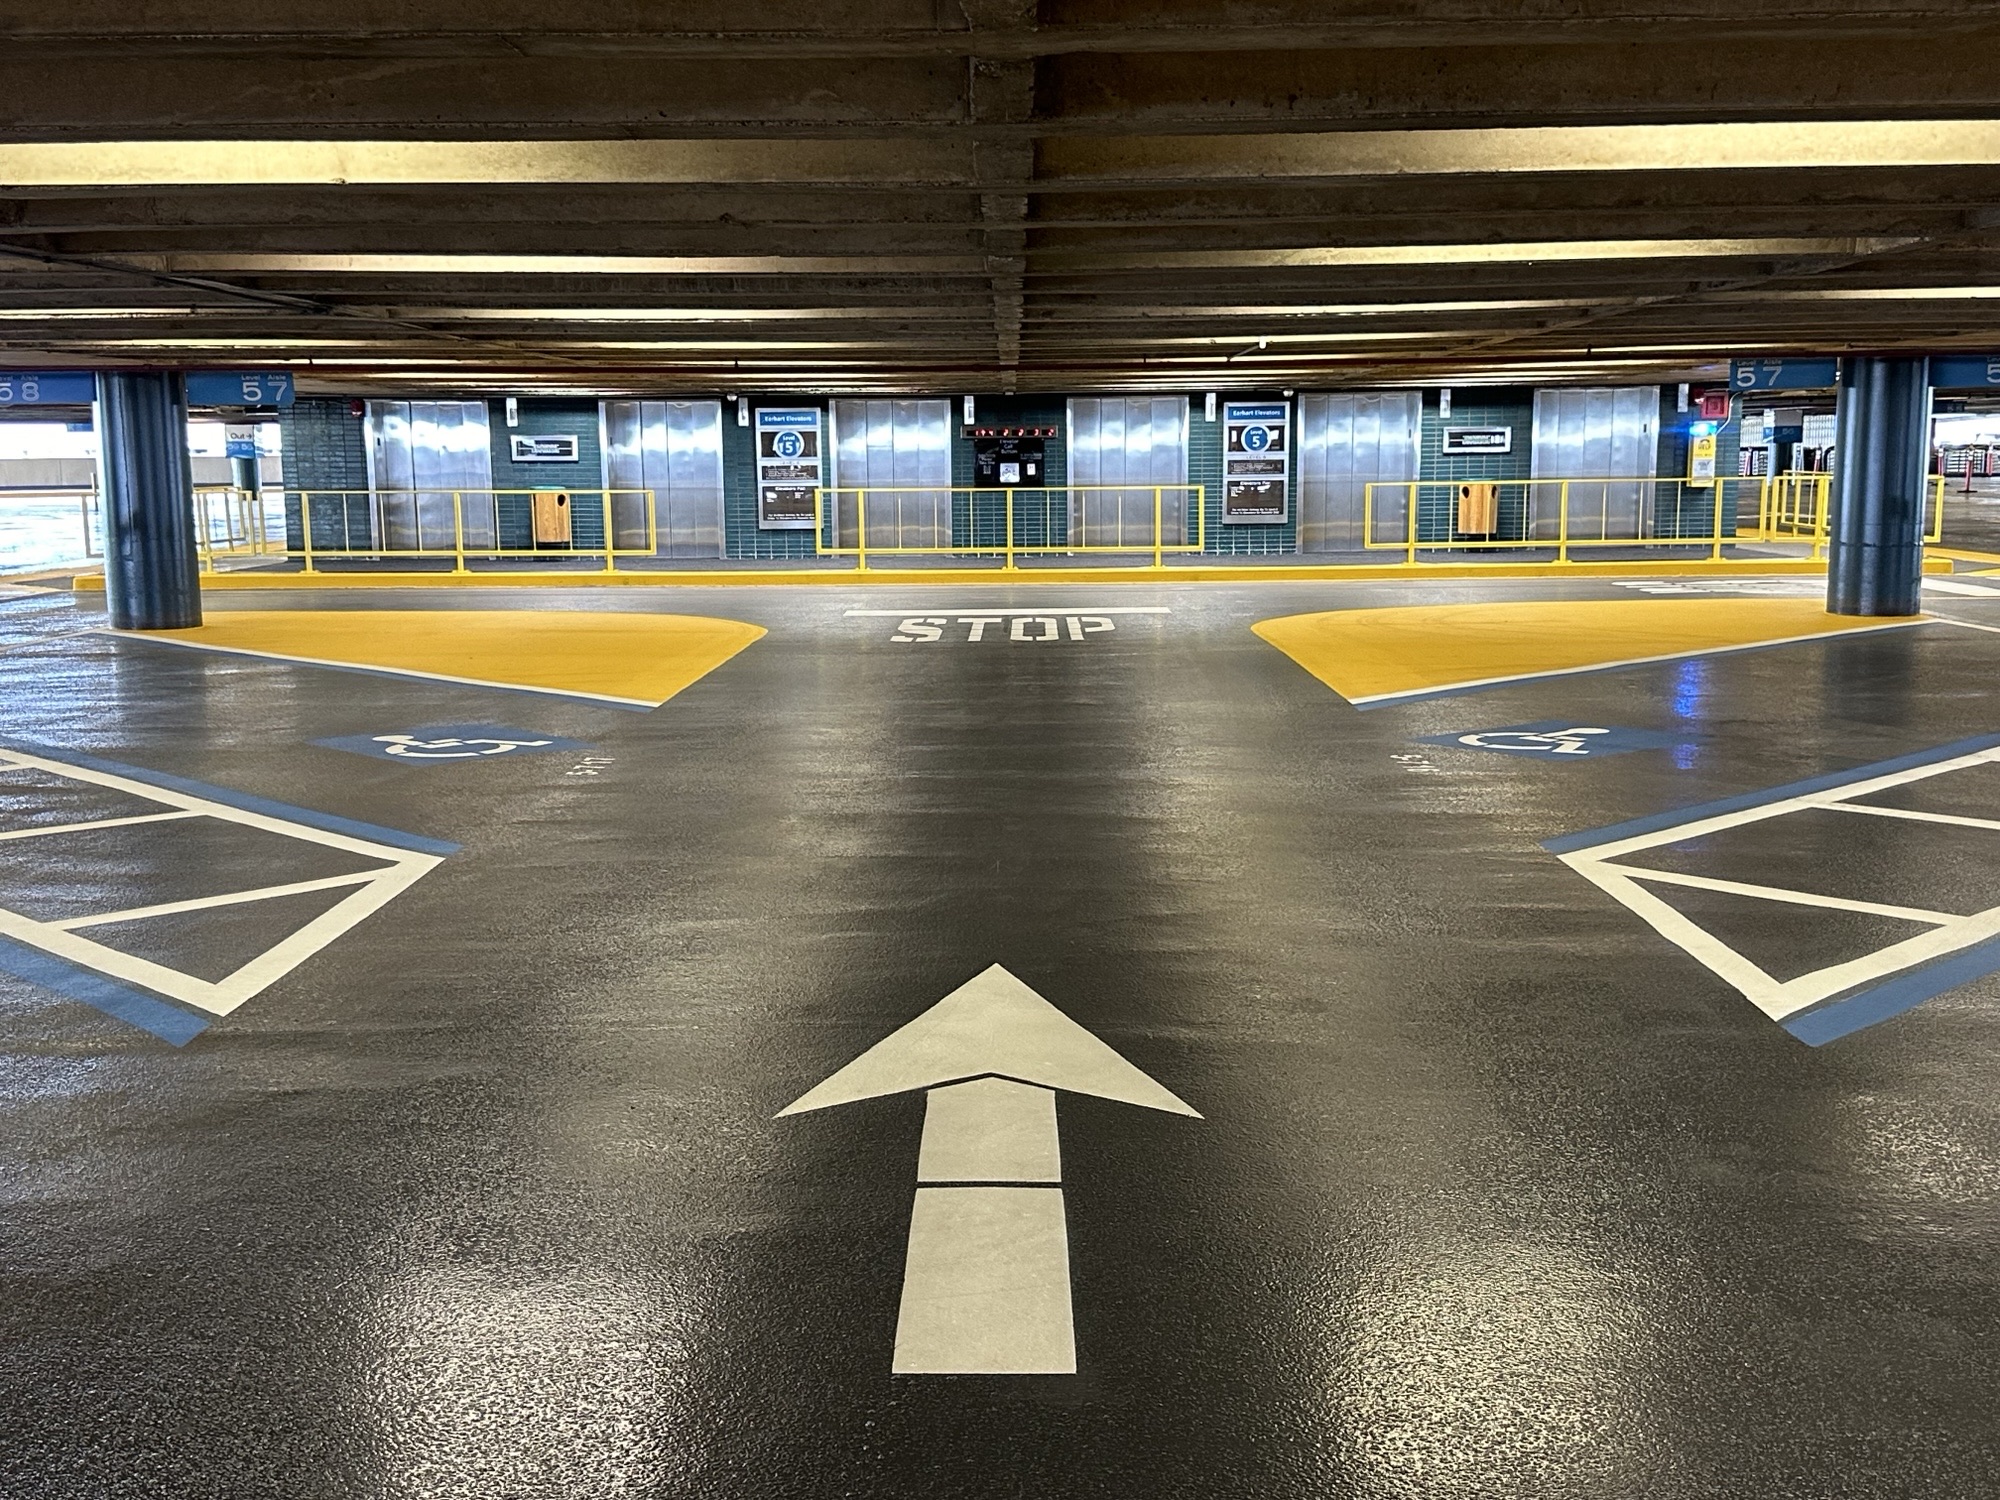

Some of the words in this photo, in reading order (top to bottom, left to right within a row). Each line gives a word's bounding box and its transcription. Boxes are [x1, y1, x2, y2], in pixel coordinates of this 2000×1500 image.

[1736, 367, 1756, 387] 5
[1763, 366, 1782, 386] 7
[1986, 364, 2000, 383] 5
[0, 382, 13, 401] 5
[22, 381, 40, 401] 8
[242, 381, 262, 401] 5
[267, 381, 287, 401] 7
[785, 441, 794, 453] 5
[1252, 435, 1260, 447] 5
[890, 616, 1116, 643] STOP
